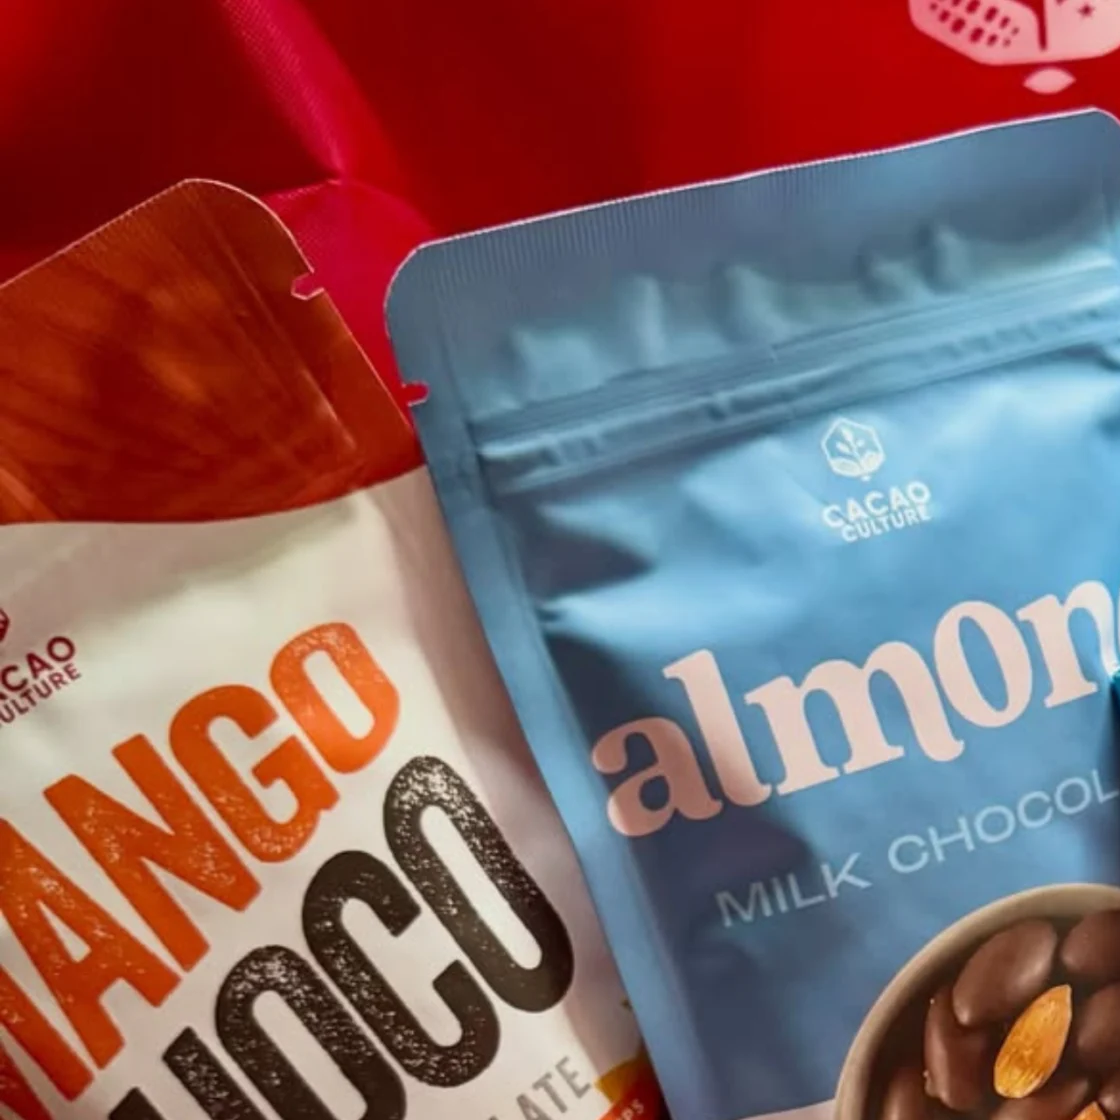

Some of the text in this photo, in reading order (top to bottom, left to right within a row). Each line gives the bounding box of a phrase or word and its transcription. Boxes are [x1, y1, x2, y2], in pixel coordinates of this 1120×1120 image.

[823, 480, 931, 528] CACAO
[841, 504, 932, 543] CULTURE
[0, 636, 75, 700] CAO
[0, 662, 81, 724] ULTURE
[714, 853, 871, 928] MILK
